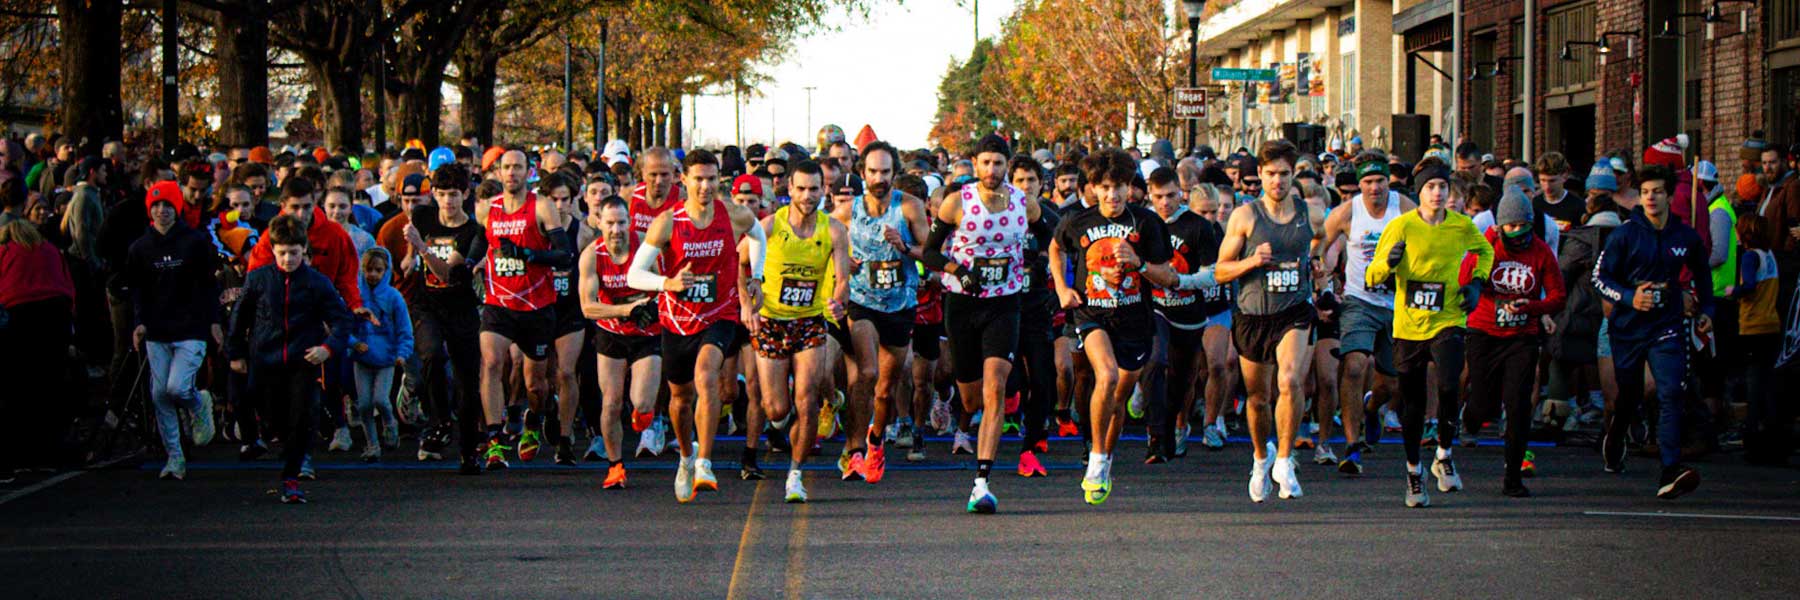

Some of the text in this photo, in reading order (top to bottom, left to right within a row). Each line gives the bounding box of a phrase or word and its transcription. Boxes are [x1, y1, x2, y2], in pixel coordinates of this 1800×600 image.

[1177, 91, 1203, 105] Regas
[1176, 104, 1205, 116] Square
[492, 219, 527, 229] RUNNERS
[493, 228, 524, 237] MARKET
[1087, 224, 1134, 243] MERRY
[683, 239, 725, 250] RUNNERS
[685, 248, 722, 258] MARKET
[877, 268, 898, 284] 531
[980, 266, 1004, 281] 738
[1265, 270, 1300, 287] 1896
[554, 277, 570, 291] 95
[781, 286, 814, 303] 2376
[1414, 290, 1438, 306] 617
